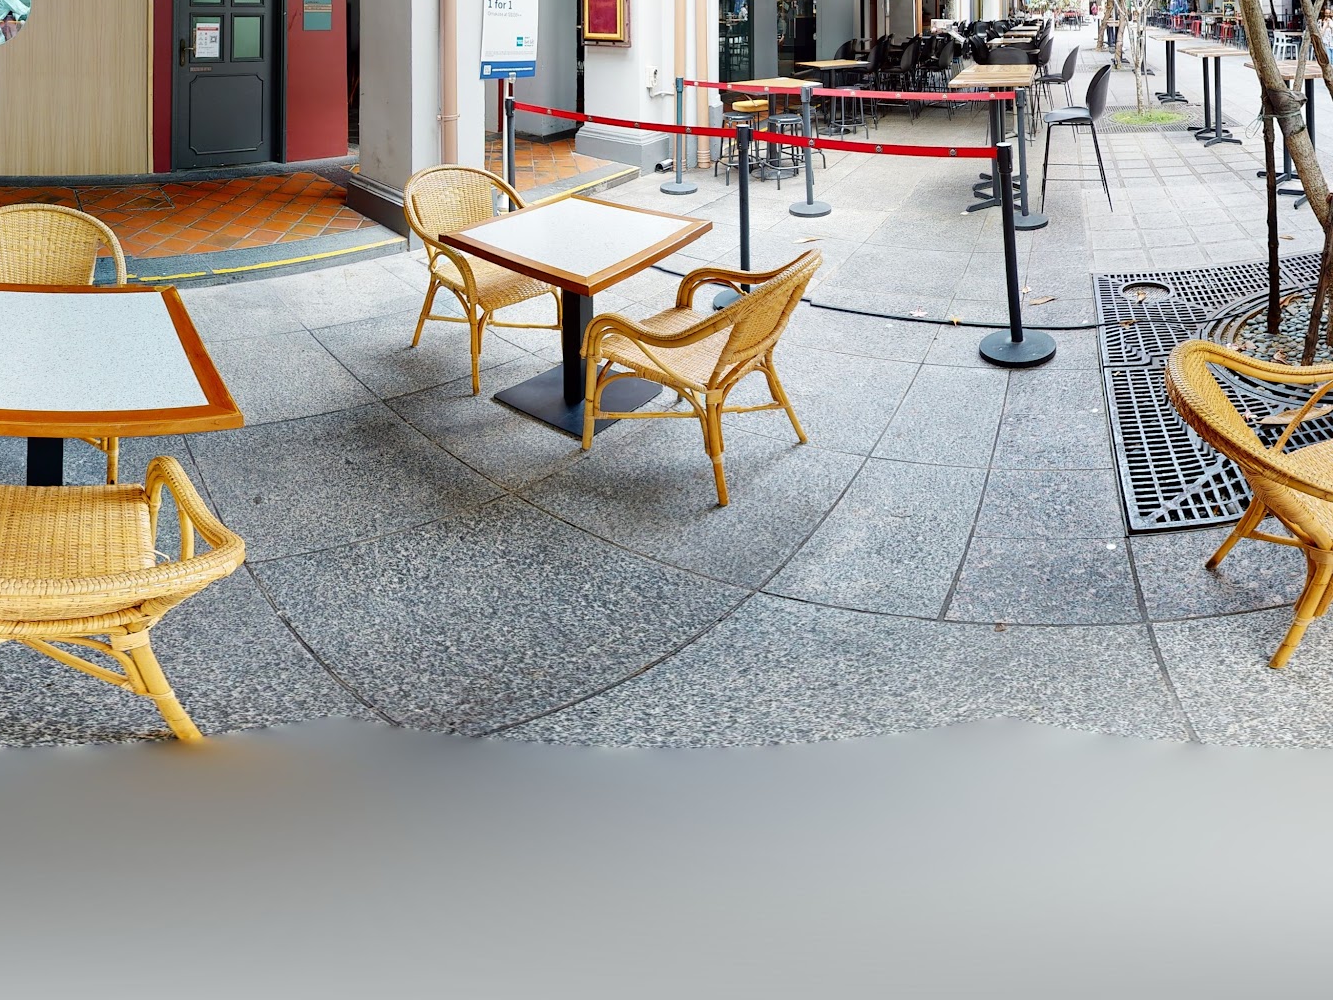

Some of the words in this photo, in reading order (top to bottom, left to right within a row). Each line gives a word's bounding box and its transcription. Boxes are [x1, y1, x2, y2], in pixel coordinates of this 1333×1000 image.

[488, 0, 492, 8] 1
[495, 0, 507, 9] for
[508, 1, 513, 9] 1
